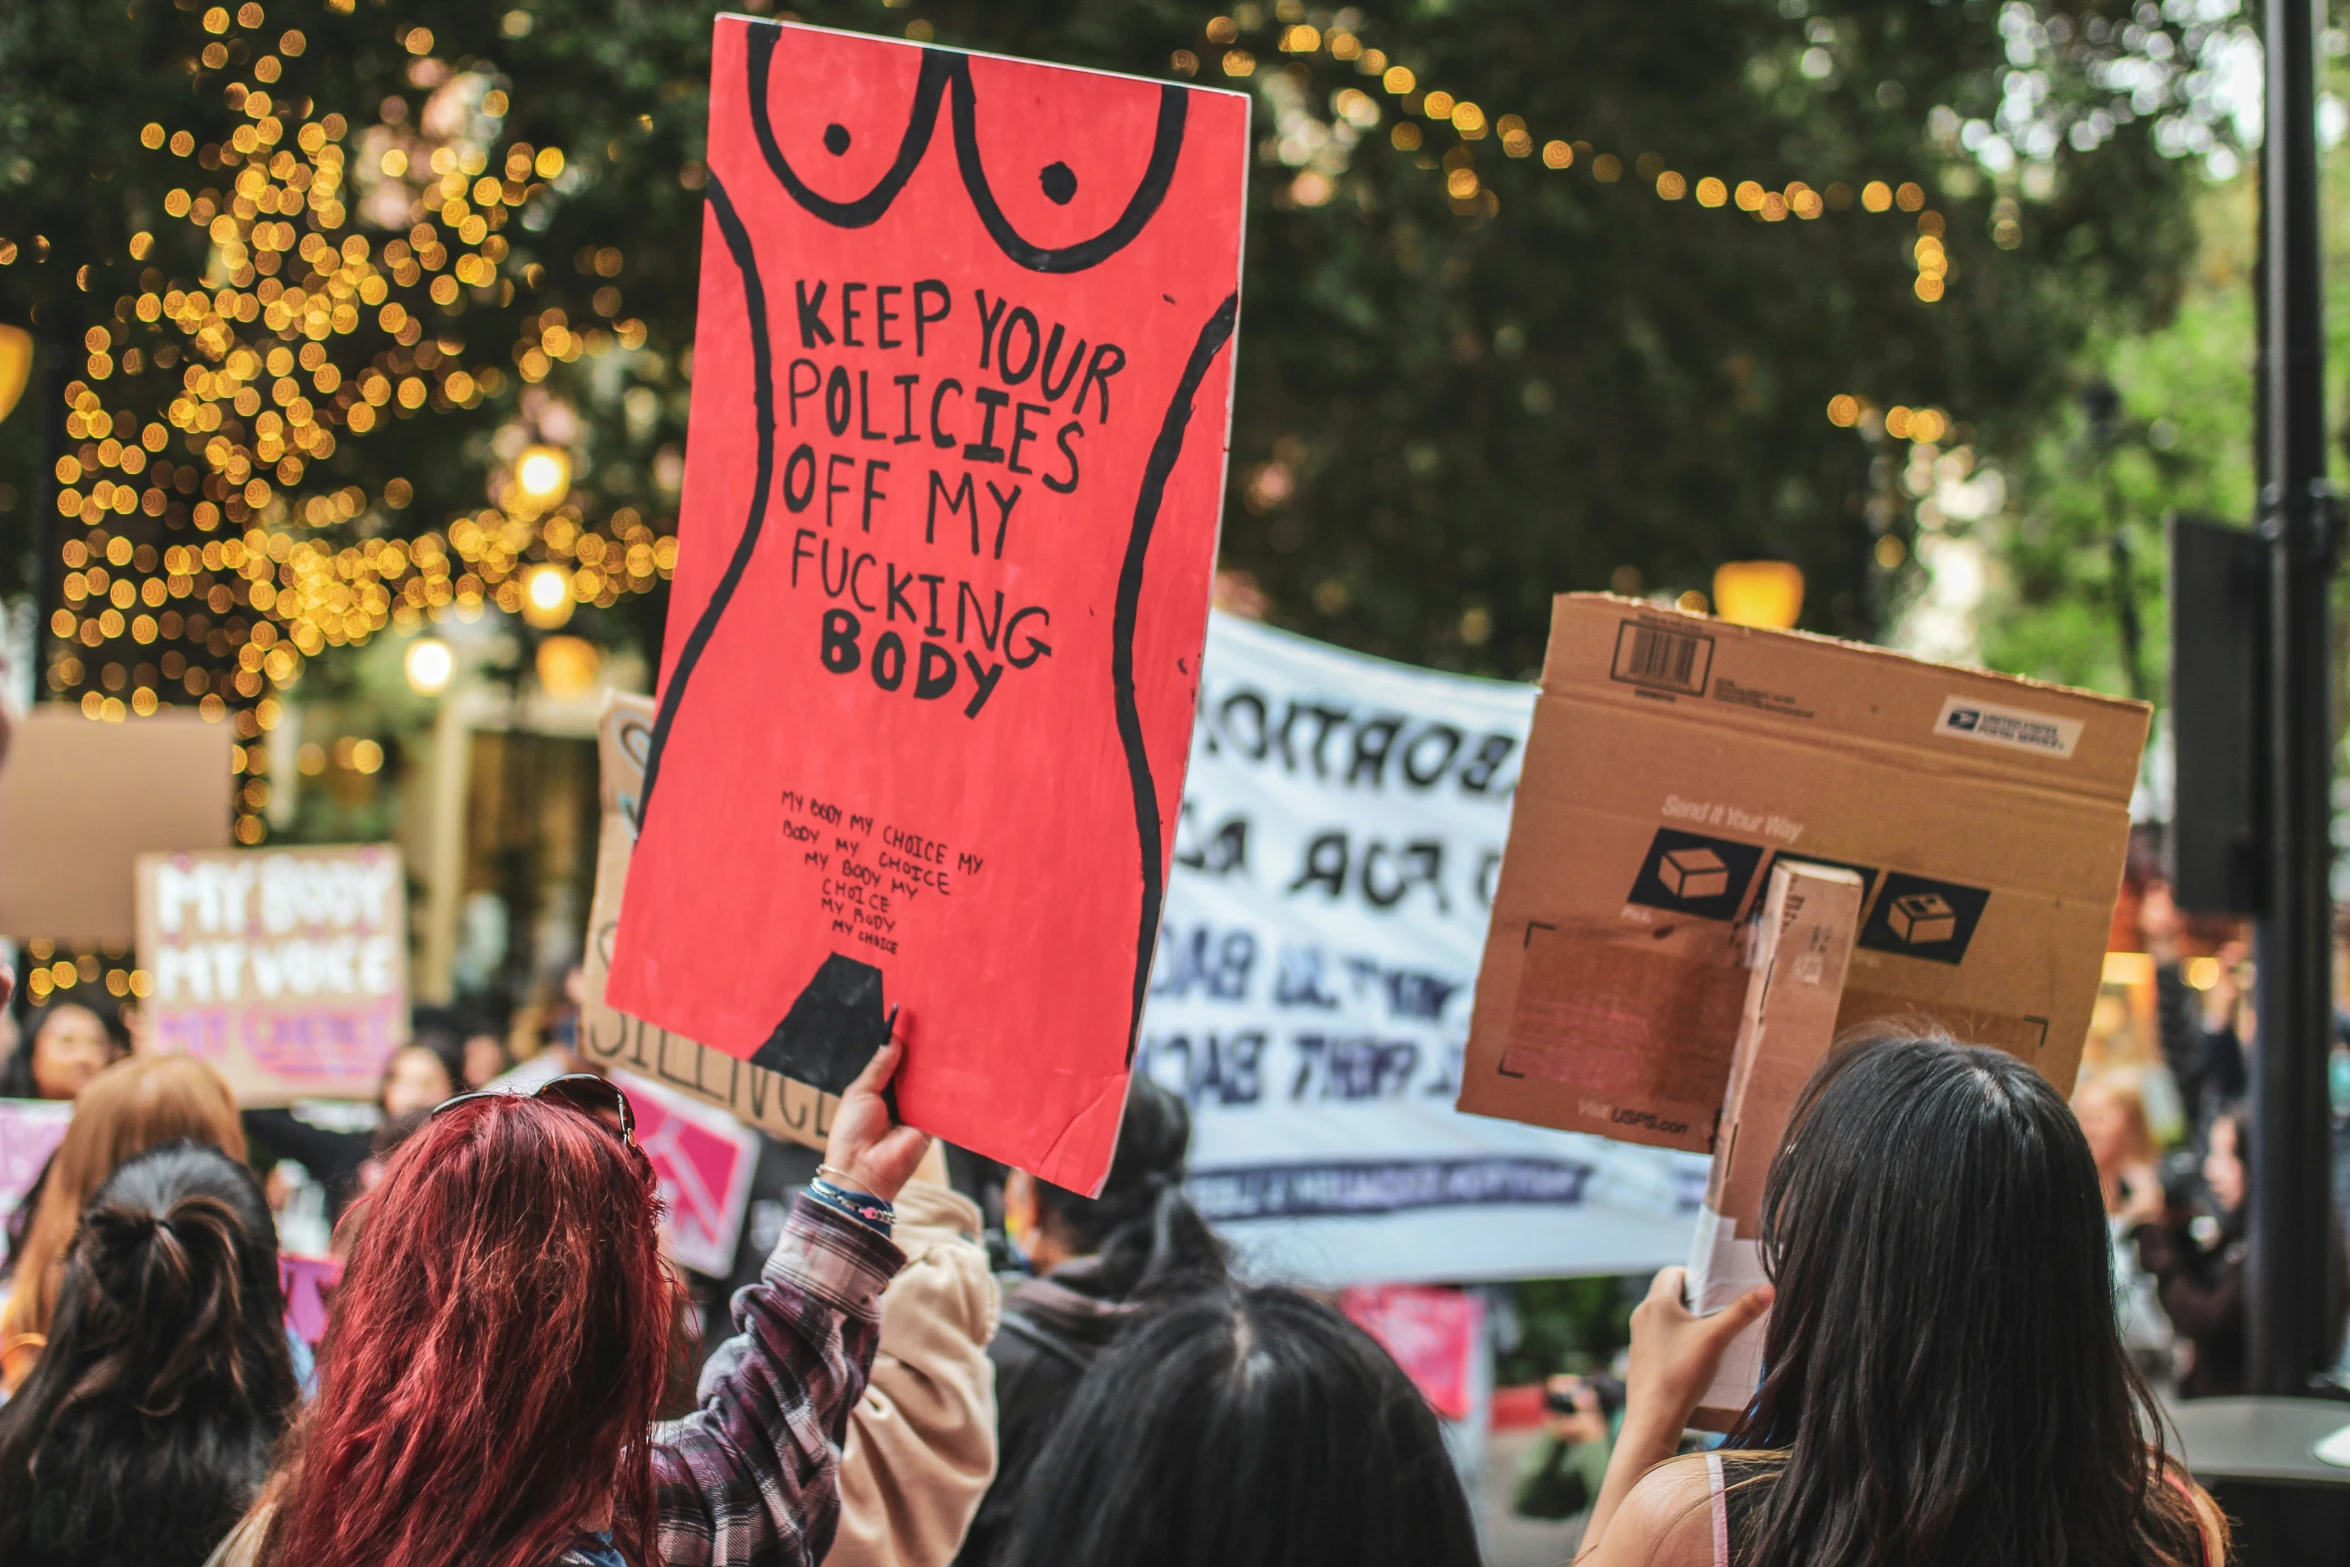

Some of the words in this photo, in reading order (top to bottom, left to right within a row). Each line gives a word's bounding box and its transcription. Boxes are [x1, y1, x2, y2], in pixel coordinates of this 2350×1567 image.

[796, 279, 951, 356] KEEP
[975, 288, 1125, 424] YOUR
[789, 358, 1084, 494] POLICIES
[783, 443, 890, 533] OFF
[926, 470, 1021, 560] MY
[792, 528, 1051, 669] FUCKING
[820, 608, 1004, 719] BODY
[781, 790, 803, 812] MY
[810, 799, 842, 827] BODY
[850, 814, 873, 836] MY
[883, 825, 947, 864] CHOICE
[957, 852, 984, 876] MY
[783, 820, 820, 845] BODY
[836, 837, 860, 858] MY
[879, 851, 950, 896] CHOICE
[1661, 794, 1710, 823] Send
[1727, 806, 1765, 832] Your
[1765, 814, 1804, 844] Way
[159, 859, 257, 934] MY
[261, 852, 398, 934] BODY
[804, 851, 829, 870] MY
[842, 859, 881, 888] BODY
[891, 878, 919, 900] MY
[821, 897, 844, 916] MY
[853, 908, 896, 933] BODY
[822, 878, 891, 914] CHOICE
[156, 937, 246, 1002] MY
[252, 934, 394, 997] VOICE
[831, 919, 854, 936] MY
[858, 931, 898, 955] CHOICE
